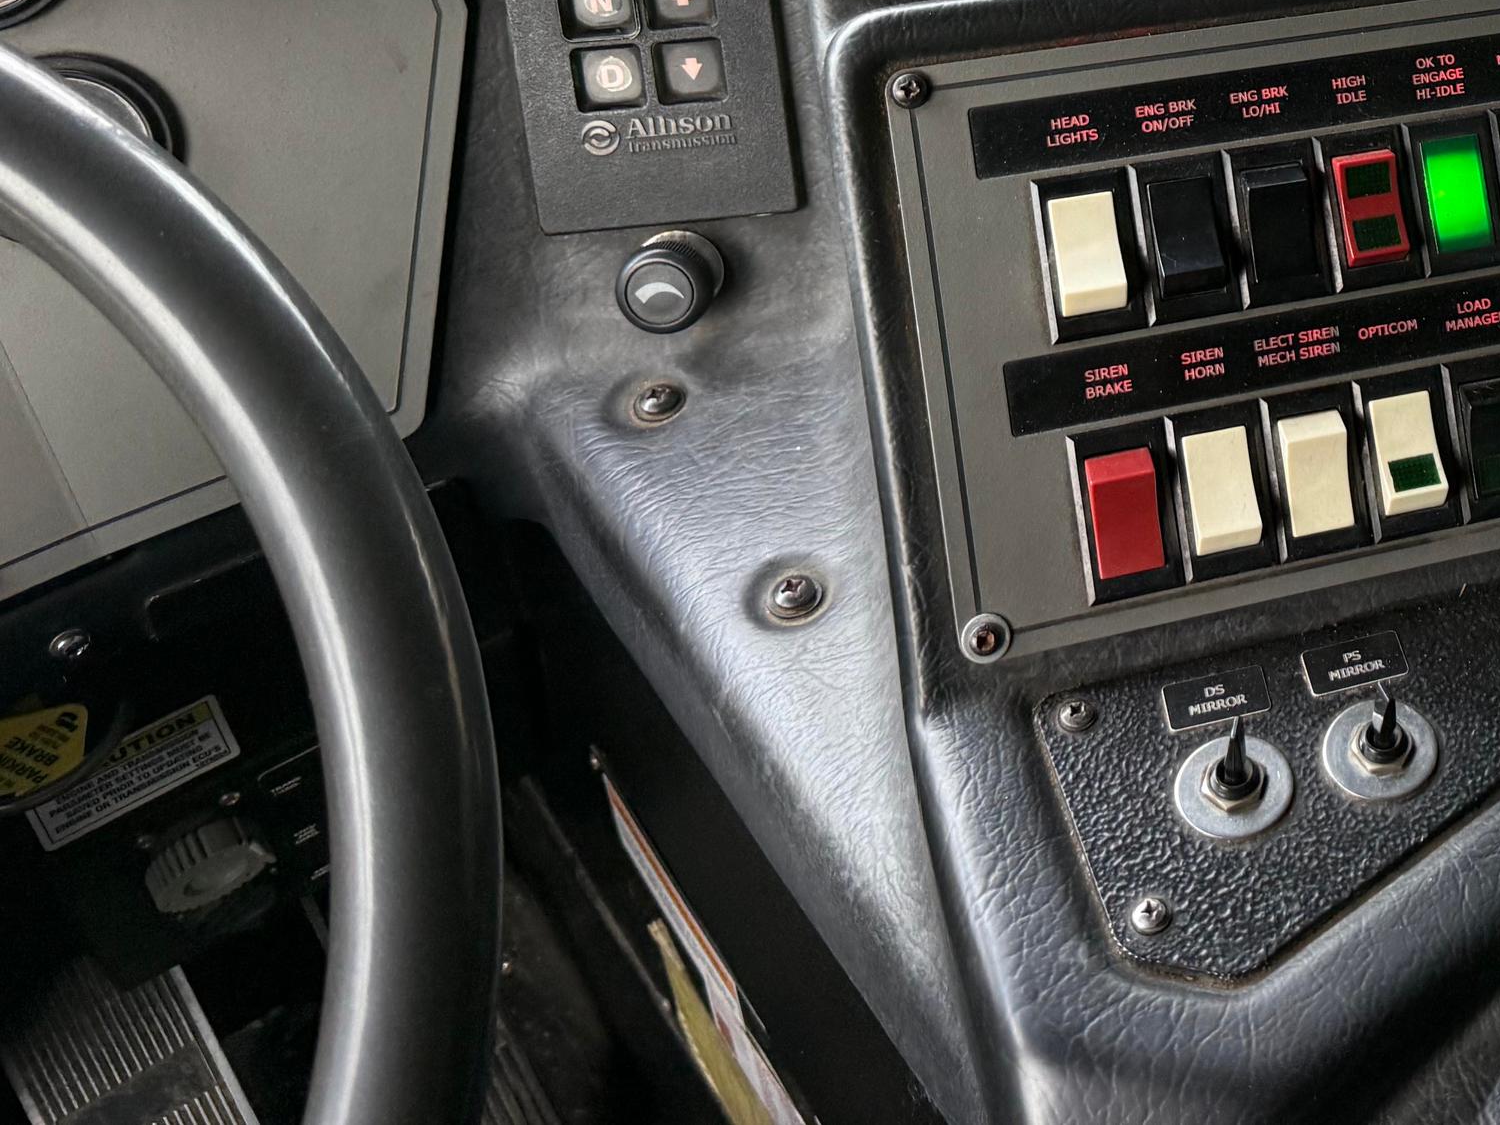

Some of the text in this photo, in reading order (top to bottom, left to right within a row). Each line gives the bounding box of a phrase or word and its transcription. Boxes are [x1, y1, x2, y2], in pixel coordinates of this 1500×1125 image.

[1415, 54, 1455, 69] OK TO
[600, 63, 627, 90] D
[1332, 75, 1366, 90] HIGH
[1412, 68, 1465, 85] ENGAGE
[1229, 85, 1289, 105] ENG BRK
[1336, 90, 1367, 105] IDLE
[1416, 83, 1465, 100] HI-IDLE
[1135, 99, 1197, 118] ENG BRK
[1242, 102, 1280, 119] LO/HI
[1051, 114, 1090, 130] HEAD
[1141, 115, 1194, 133] ON/OFF
[1047, 129, 1099, 147] LIGHTS
[1456, 298, 1491, 314] LOAD
[1253, 325, 1340, 352] ELECT SIREN
[1358, 319, 1418, 340] OPTICOM
[1180, 347, 1224, 365] SIREN
[1257, 342, 1341, 368] MECH SIREN
[1084, 363, 1129, 383] SIREN
[1184, 362, 1225, 381] HORN
[1085, 379, 1133, 400] BRAKE
[1343, 650, 1362, 663] PS
[1328, 659, 1385, 682] MIRROR
[1204, 684, 1225, 698] DS
[1188, 694, 1248, 716] MIRROR
[100, 711, 197, 768] UTION
[97, 767, 119, 784] AND
[137, 771, 151, 783] TO
[95, 800, 110, 813] OR
